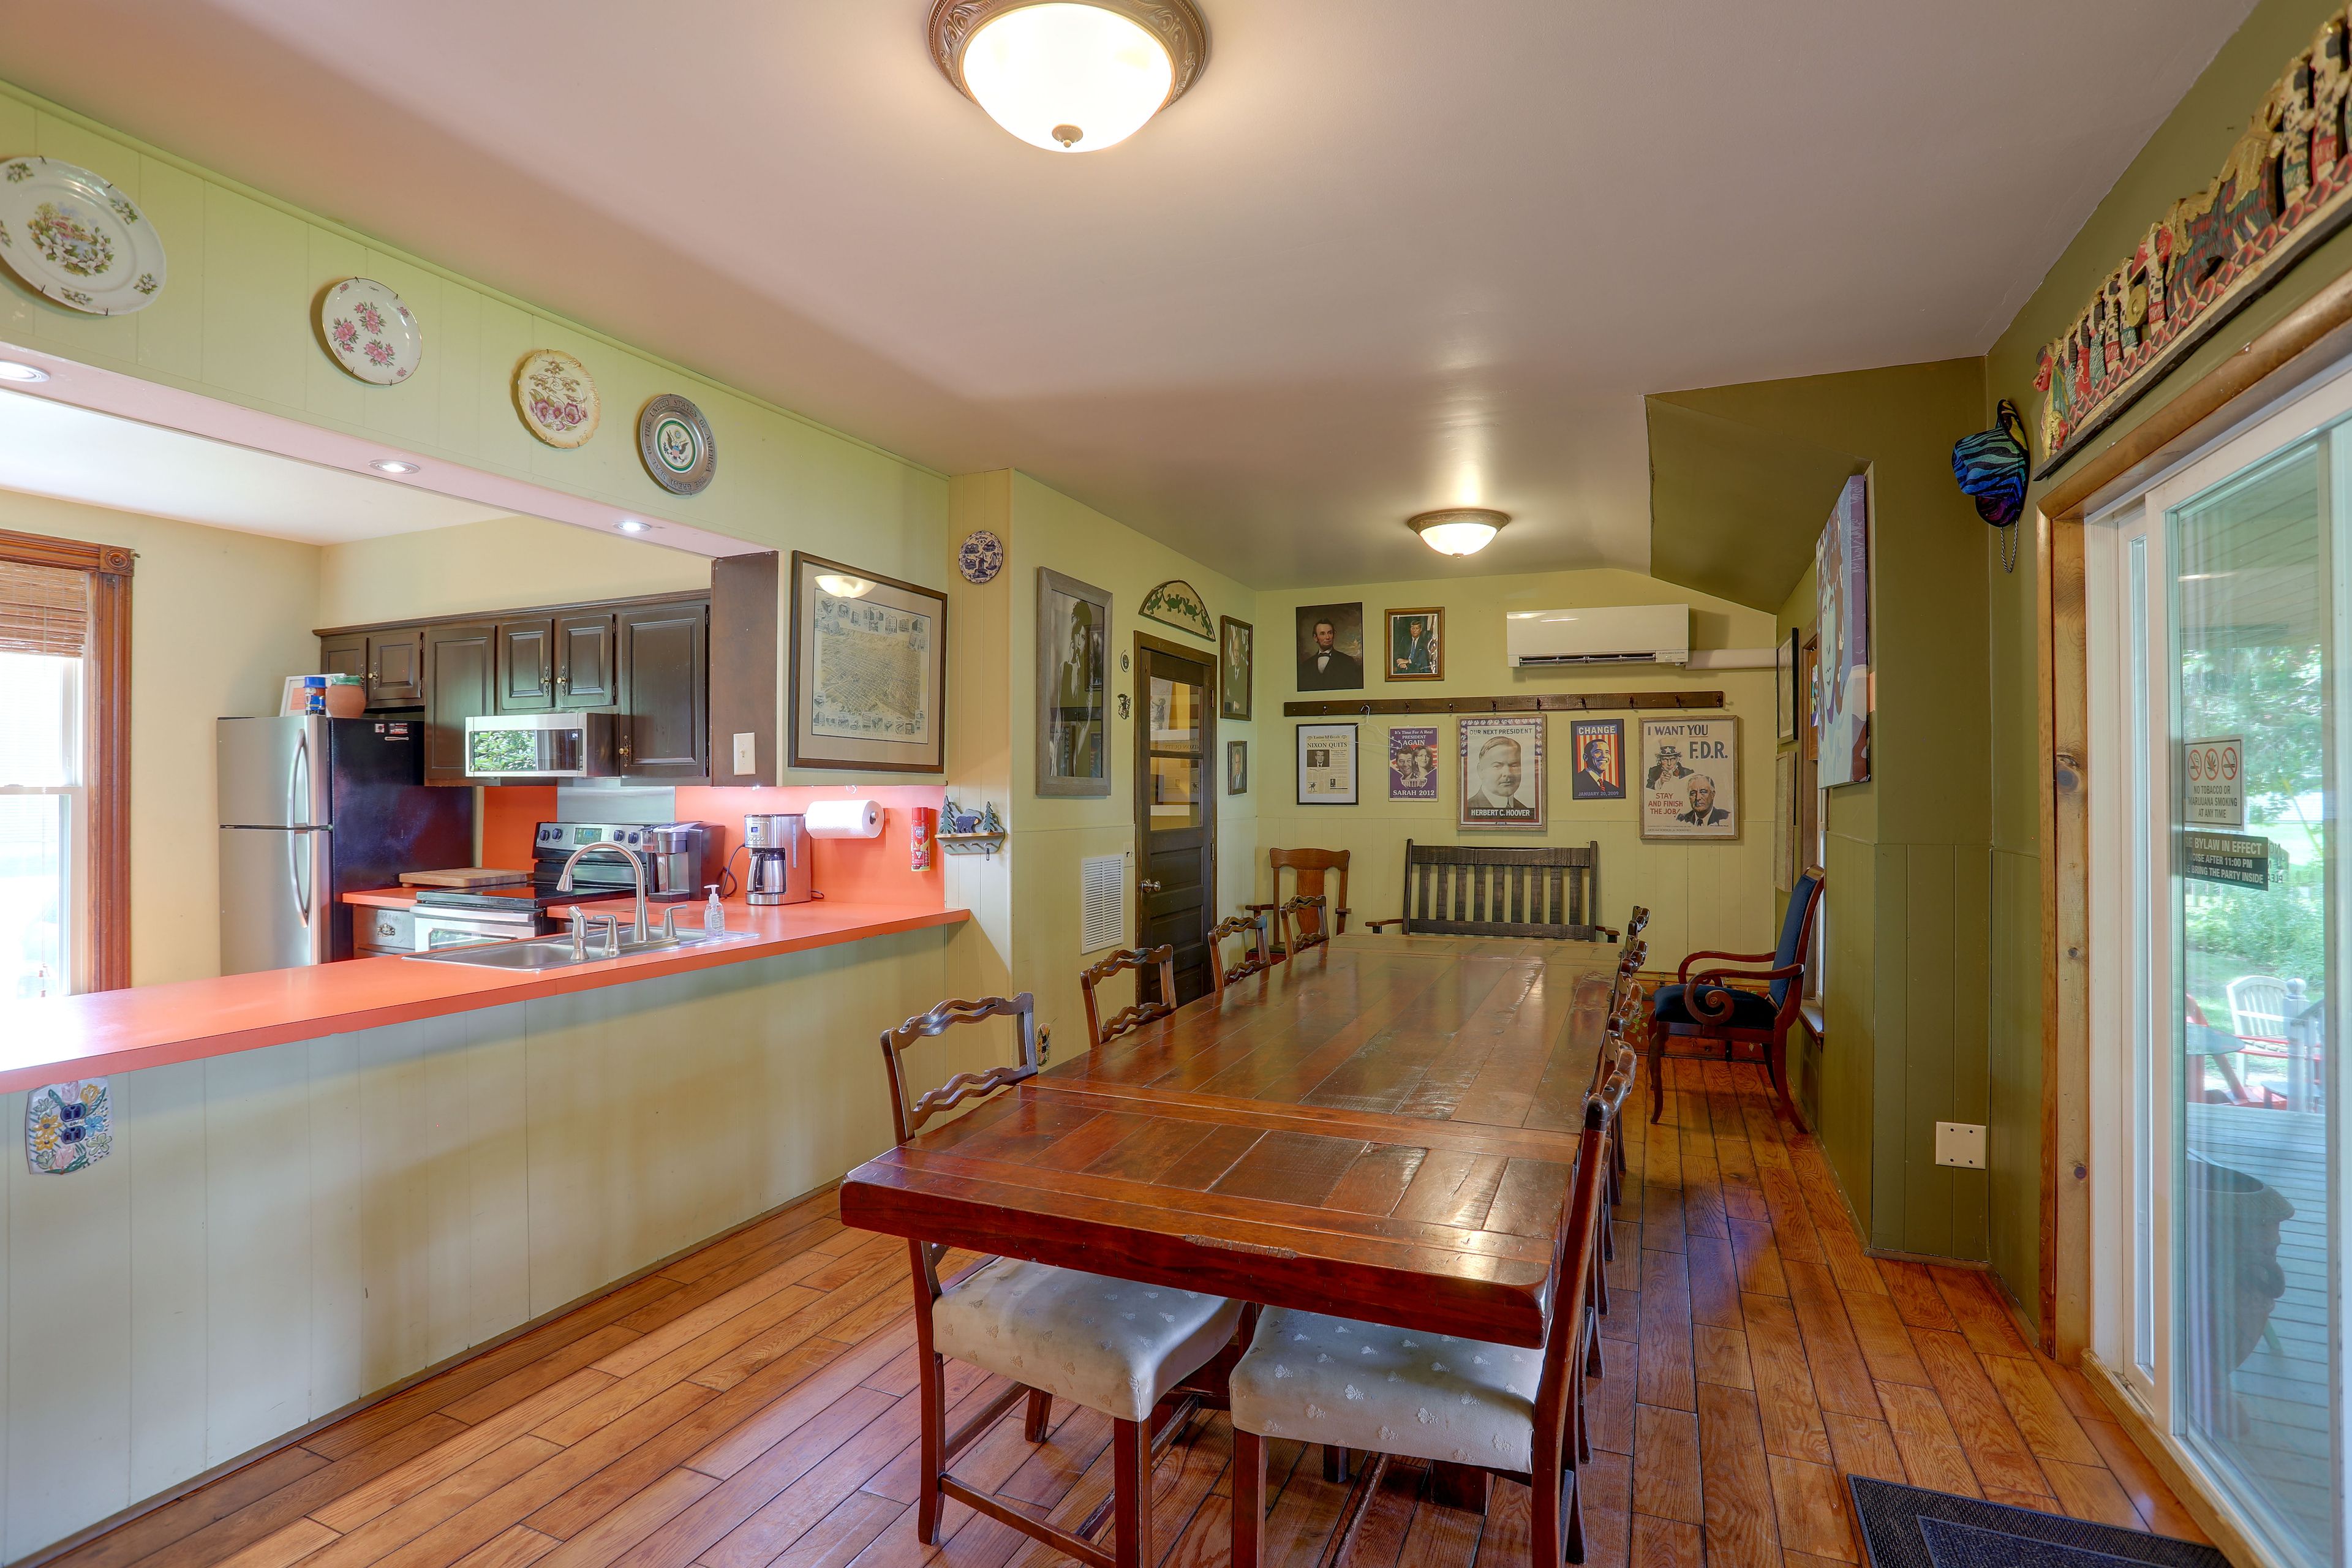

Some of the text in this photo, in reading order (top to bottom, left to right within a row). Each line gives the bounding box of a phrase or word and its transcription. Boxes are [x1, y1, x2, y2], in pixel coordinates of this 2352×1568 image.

[649, 399, 669, 417] UNITED
[674, 399, 698, 418] STATES
[699, 419, 707, 429] OF
[705, 432, 714, 472] AMERICA
[653, 458, 668, 480] SEAL
[671, 480, 692, 490] GREAT
[1578, 726, 1616, 734] CHANGE
[1648, 724, 1708, 736] I WANT YOU
[1689, 741, 1728, 760] F.D.R.
[2193, 785, 2231, 794] NO TOBACCO OR
[2188, 797, 2237, 807] MARIJUANA SMOKING
[1663, 809, 1680, 818] JOB!
[2198, 809, 2226, 818] AT ANY TIME
[2195, 837, 2220, 851] BYLAW
[2222, 840, 2230, 852] IN
[2232, 841, 2262, 855] EFFECT
[2206, 854, 2223, 865] AFTER
[2225, 857, 2241, 867] 11:00
[2242, 858, 2253, 869] PM
[2192, 865, 2209, 876] BRING
[2209, 867, 2220, 878] THE
[2221, 869, 2241, 881] PARTY
[2242, 872, 2264, 884] INSIDE
